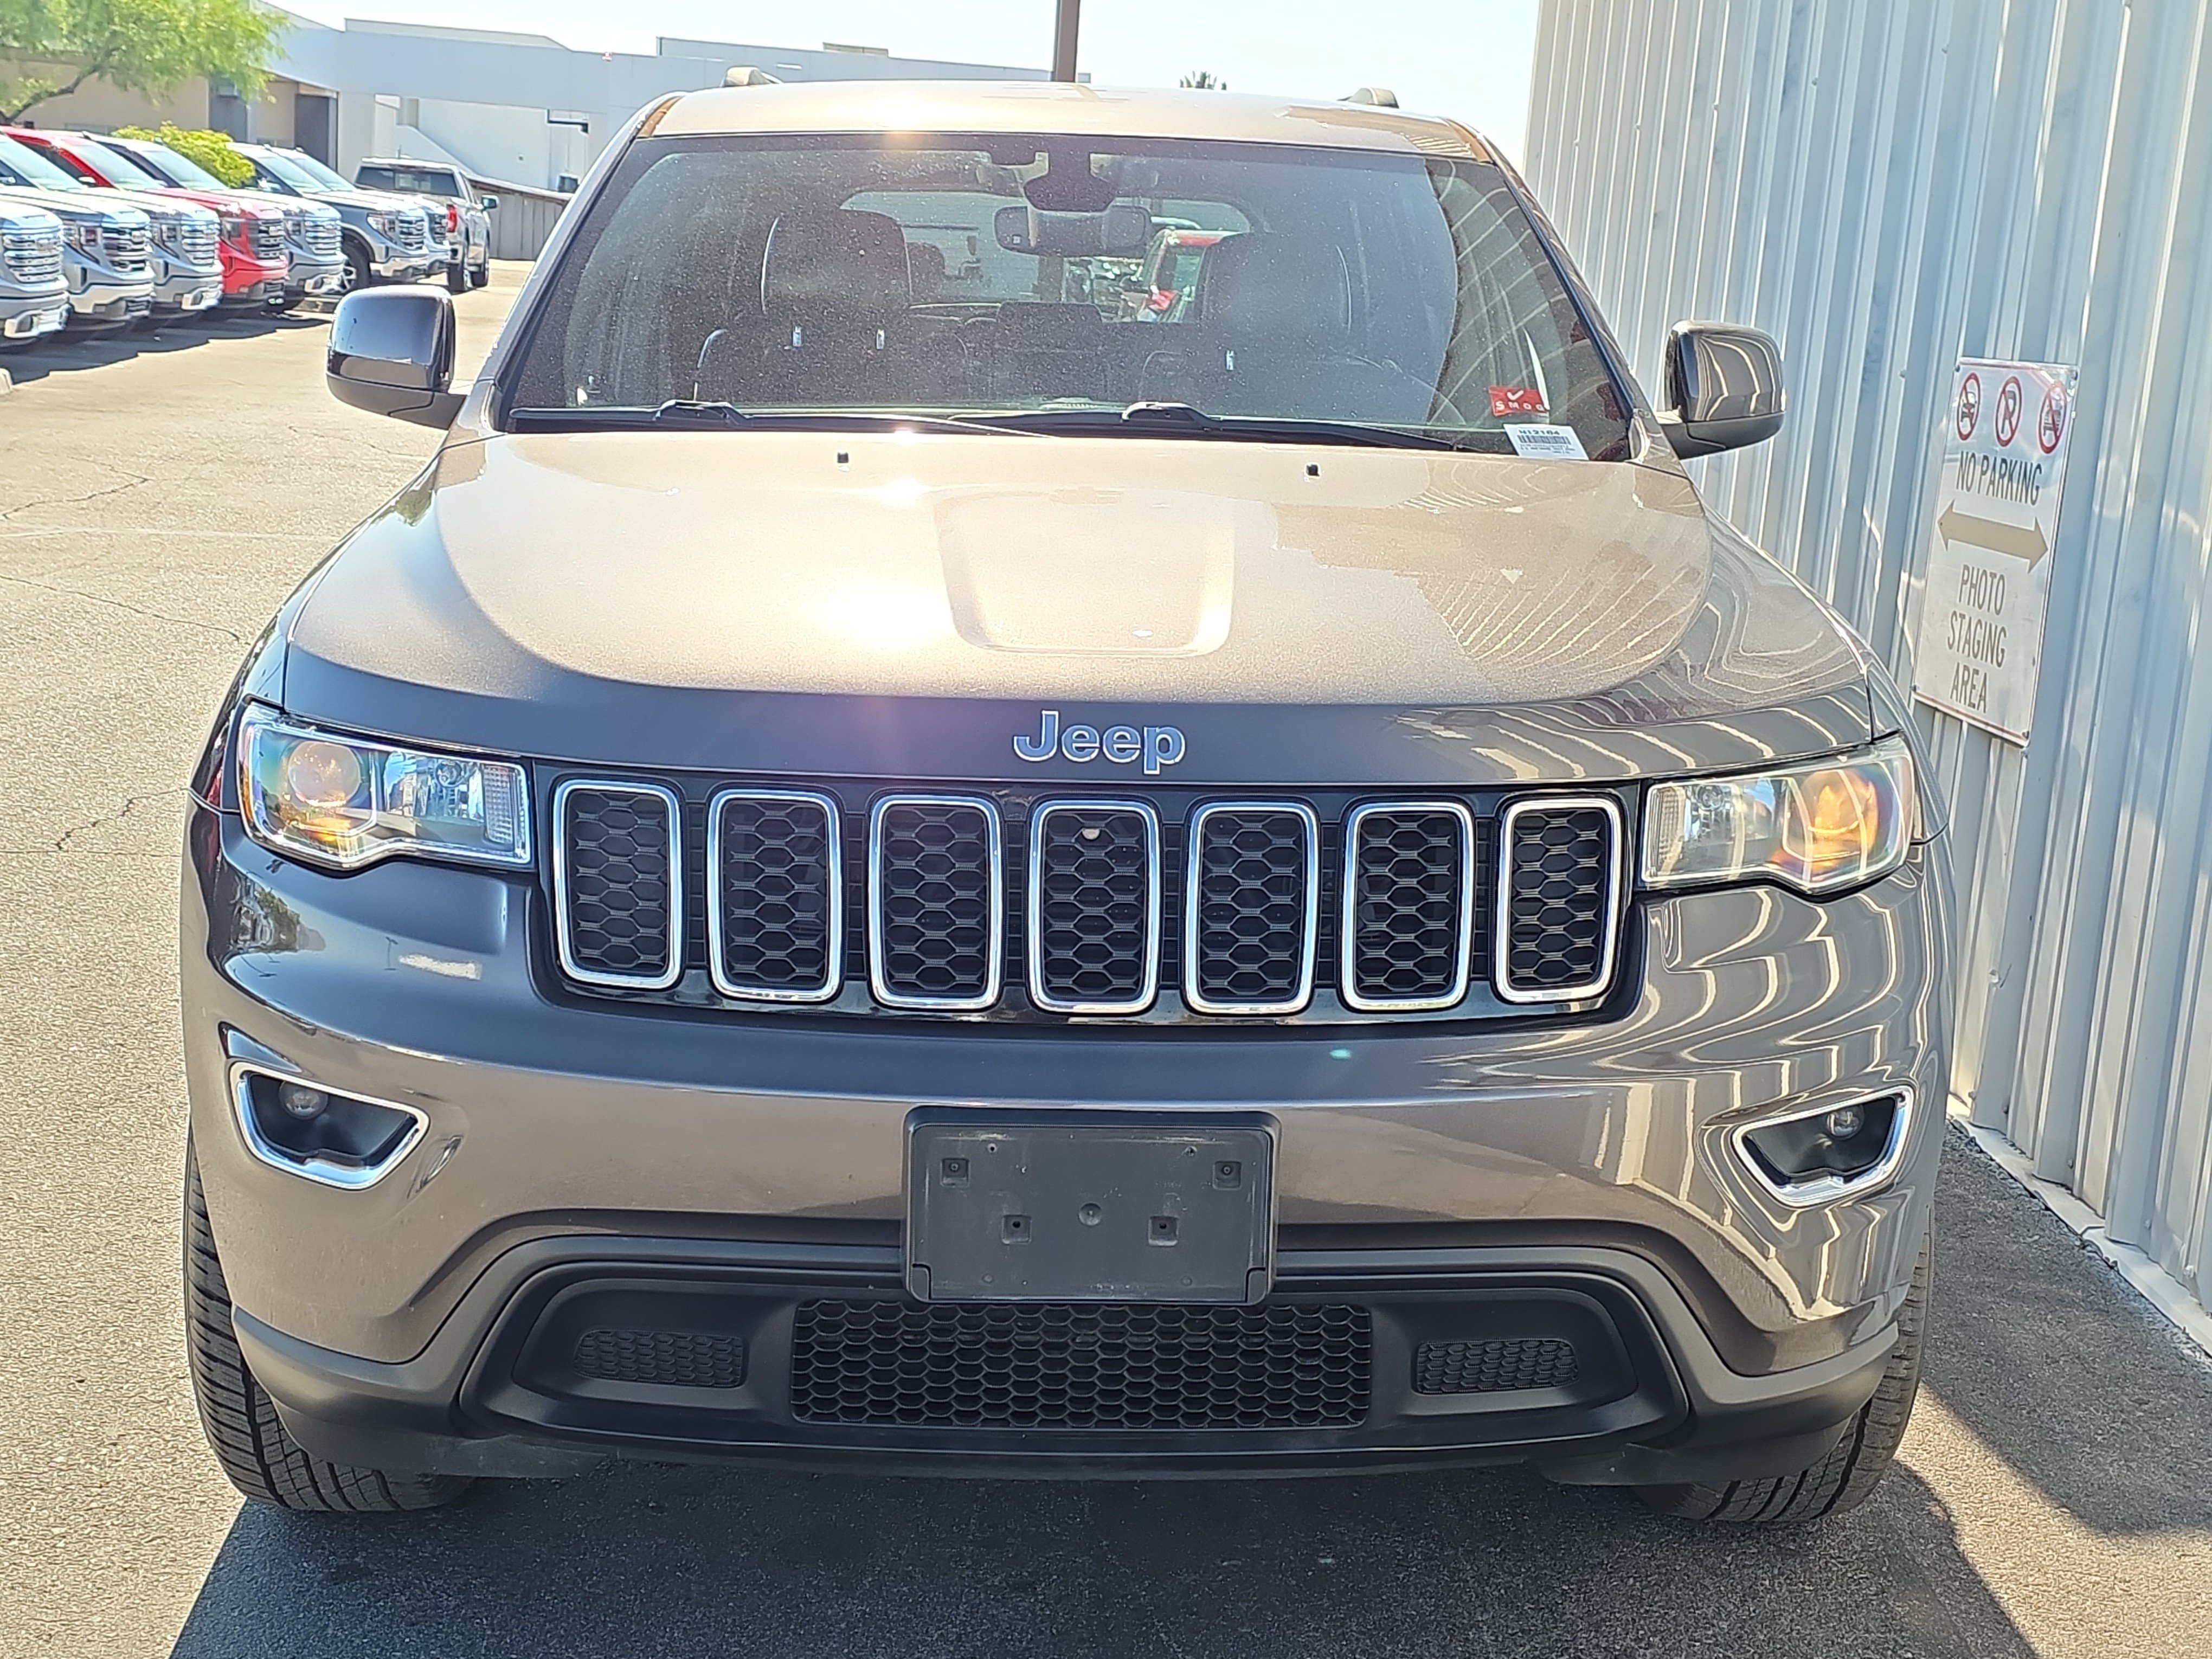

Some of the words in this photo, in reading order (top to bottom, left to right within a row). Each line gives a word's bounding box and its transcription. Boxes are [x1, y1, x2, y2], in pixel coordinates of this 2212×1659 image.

[1956, 451, 1976, 492] NO
[1977, 454, 2042, 506] PARKING
[1958, 564, 2005, 616] PHOTO
[1947, 609, 2007, 668] STAGING
[1950, 661, 1987, 714] AREA
[1013, 710, 1186, 775] Jeep
